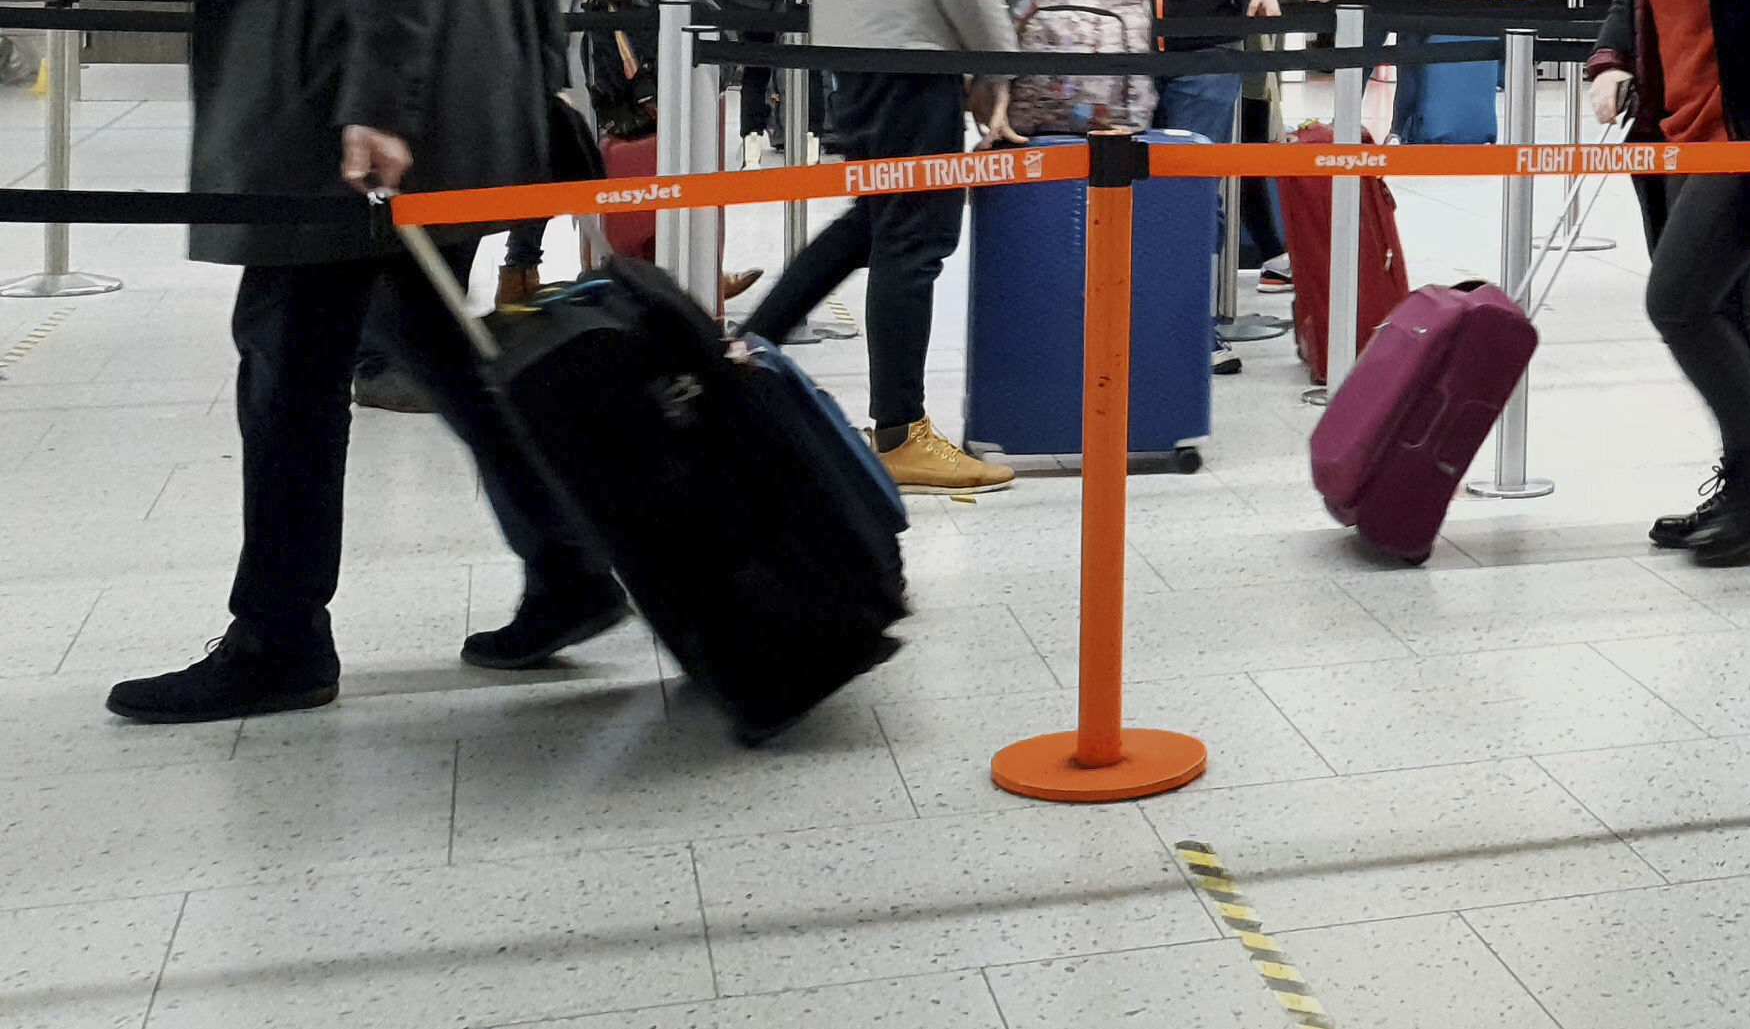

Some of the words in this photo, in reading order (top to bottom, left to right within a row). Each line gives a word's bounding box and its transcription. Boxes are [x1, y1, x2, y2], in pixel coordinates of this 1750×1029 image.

[1314, 151, 1387, 170] easyJet
[1516, 146, 1577, 173] FLIGHT
[1581, 146, 1656, 171] TRACKER
[845, 160, 916, 193] FLIGHT
[921, 153, 1016, 187] TRACKER
[595, 184, 682, 205] easyJet
